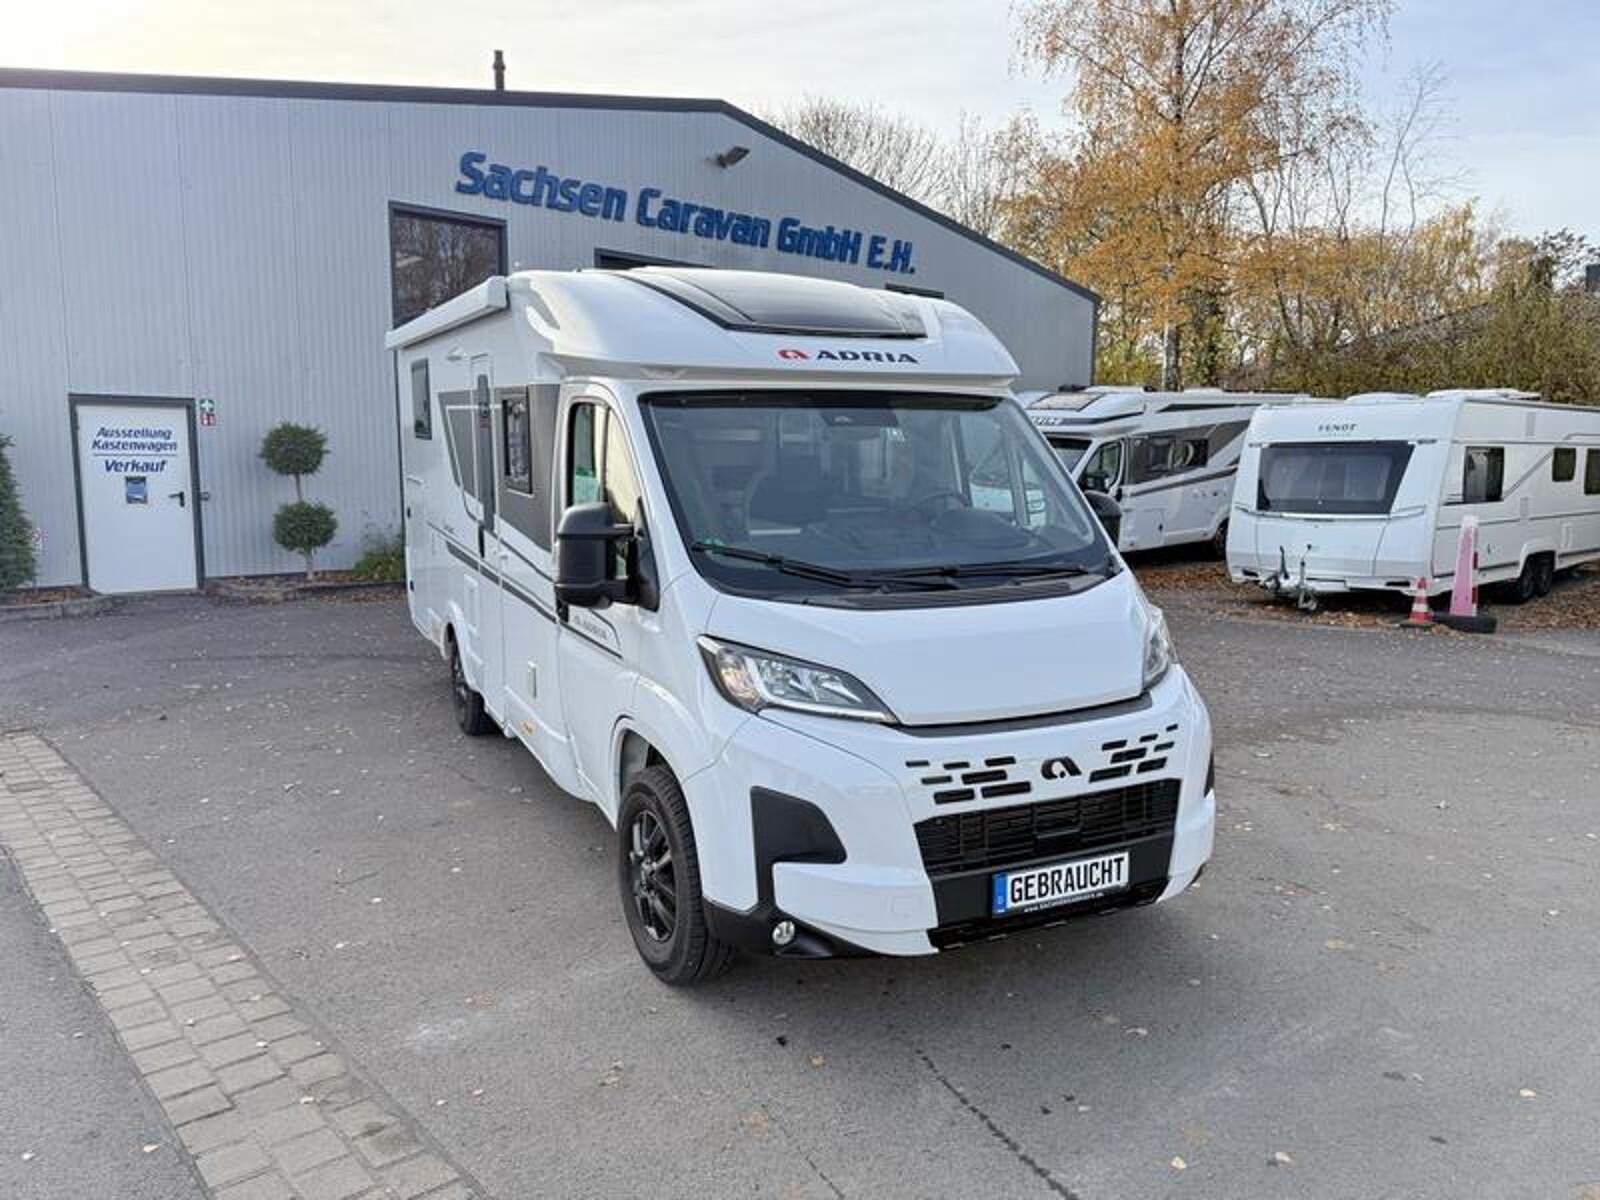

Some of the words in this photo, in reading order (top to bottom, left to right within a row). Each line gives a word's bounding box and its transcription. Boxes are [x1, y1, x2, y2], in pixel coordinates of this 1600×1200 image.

[455, 151, 626, 222] Sachsen
[639, 187, 770, 250] Caravan
[777, 216, 862, 264] GmbH
[868, 235, 917, 275] E.H.
[817, 349, 919, 364] ADRIA
[97, 427, 172, 439] Ausstellung
[93, 440, 177, 452] Kastenwagen
[105, 460, 167, 473] Verkauf
[1010, 857, 1125, 904] GEBRAUCHT
